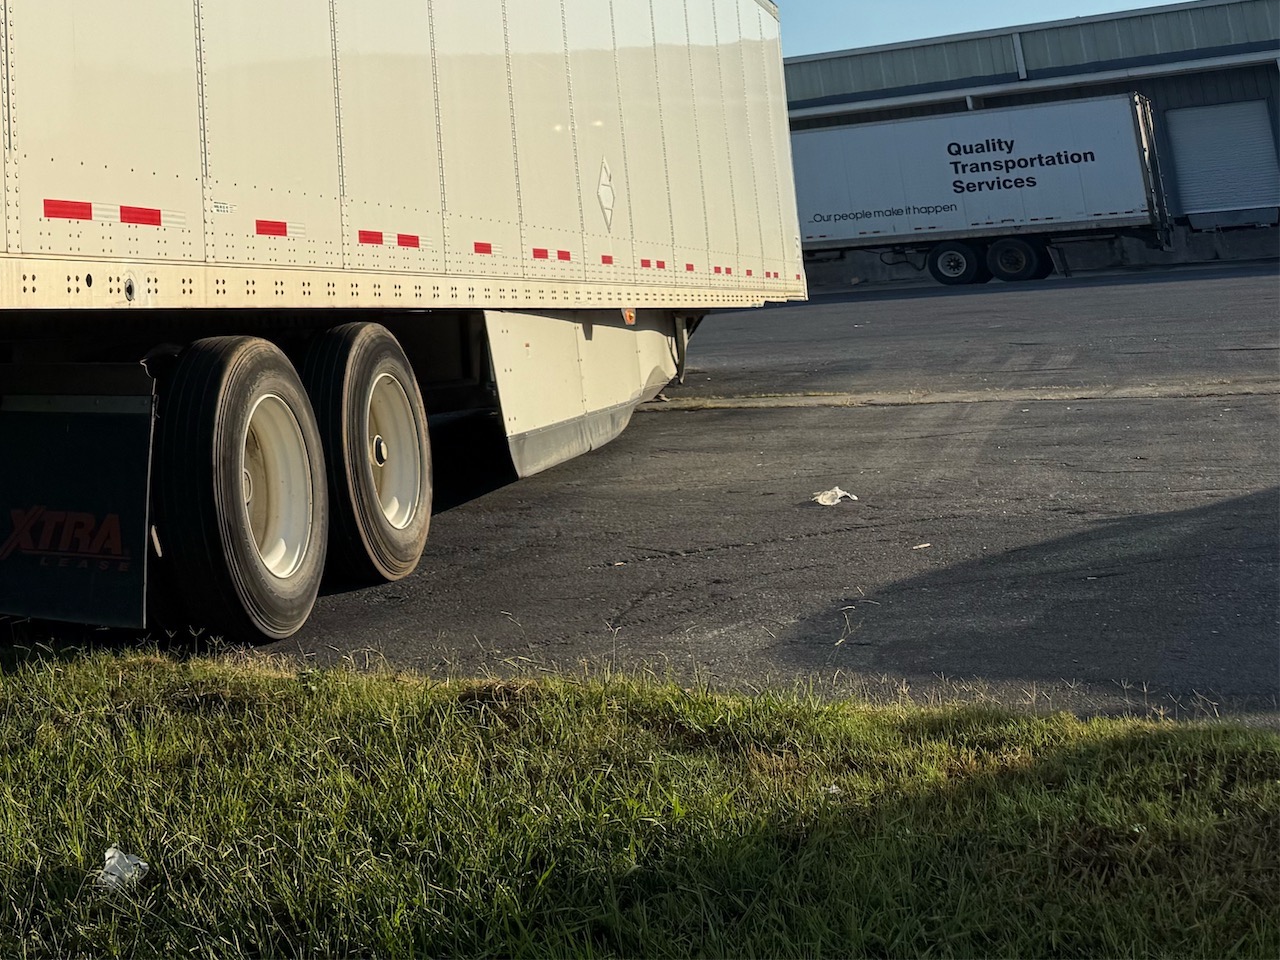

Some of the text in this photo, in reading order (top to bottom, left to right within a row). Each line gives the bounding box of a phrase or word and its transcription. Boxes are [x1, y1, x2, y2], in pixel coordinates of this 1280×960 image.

[947, 138, 1015, 156] Quality
[949, 149, 1096, 174] Transportation
[952, 175, 1037, 194] Services
[834, 210, 872, 223] people
[873, 207, 904, 218] make
[905, 205, 911, 215] it
[912, 203, 958, 216] happen
[40, 557, 131, 572] LEASE
